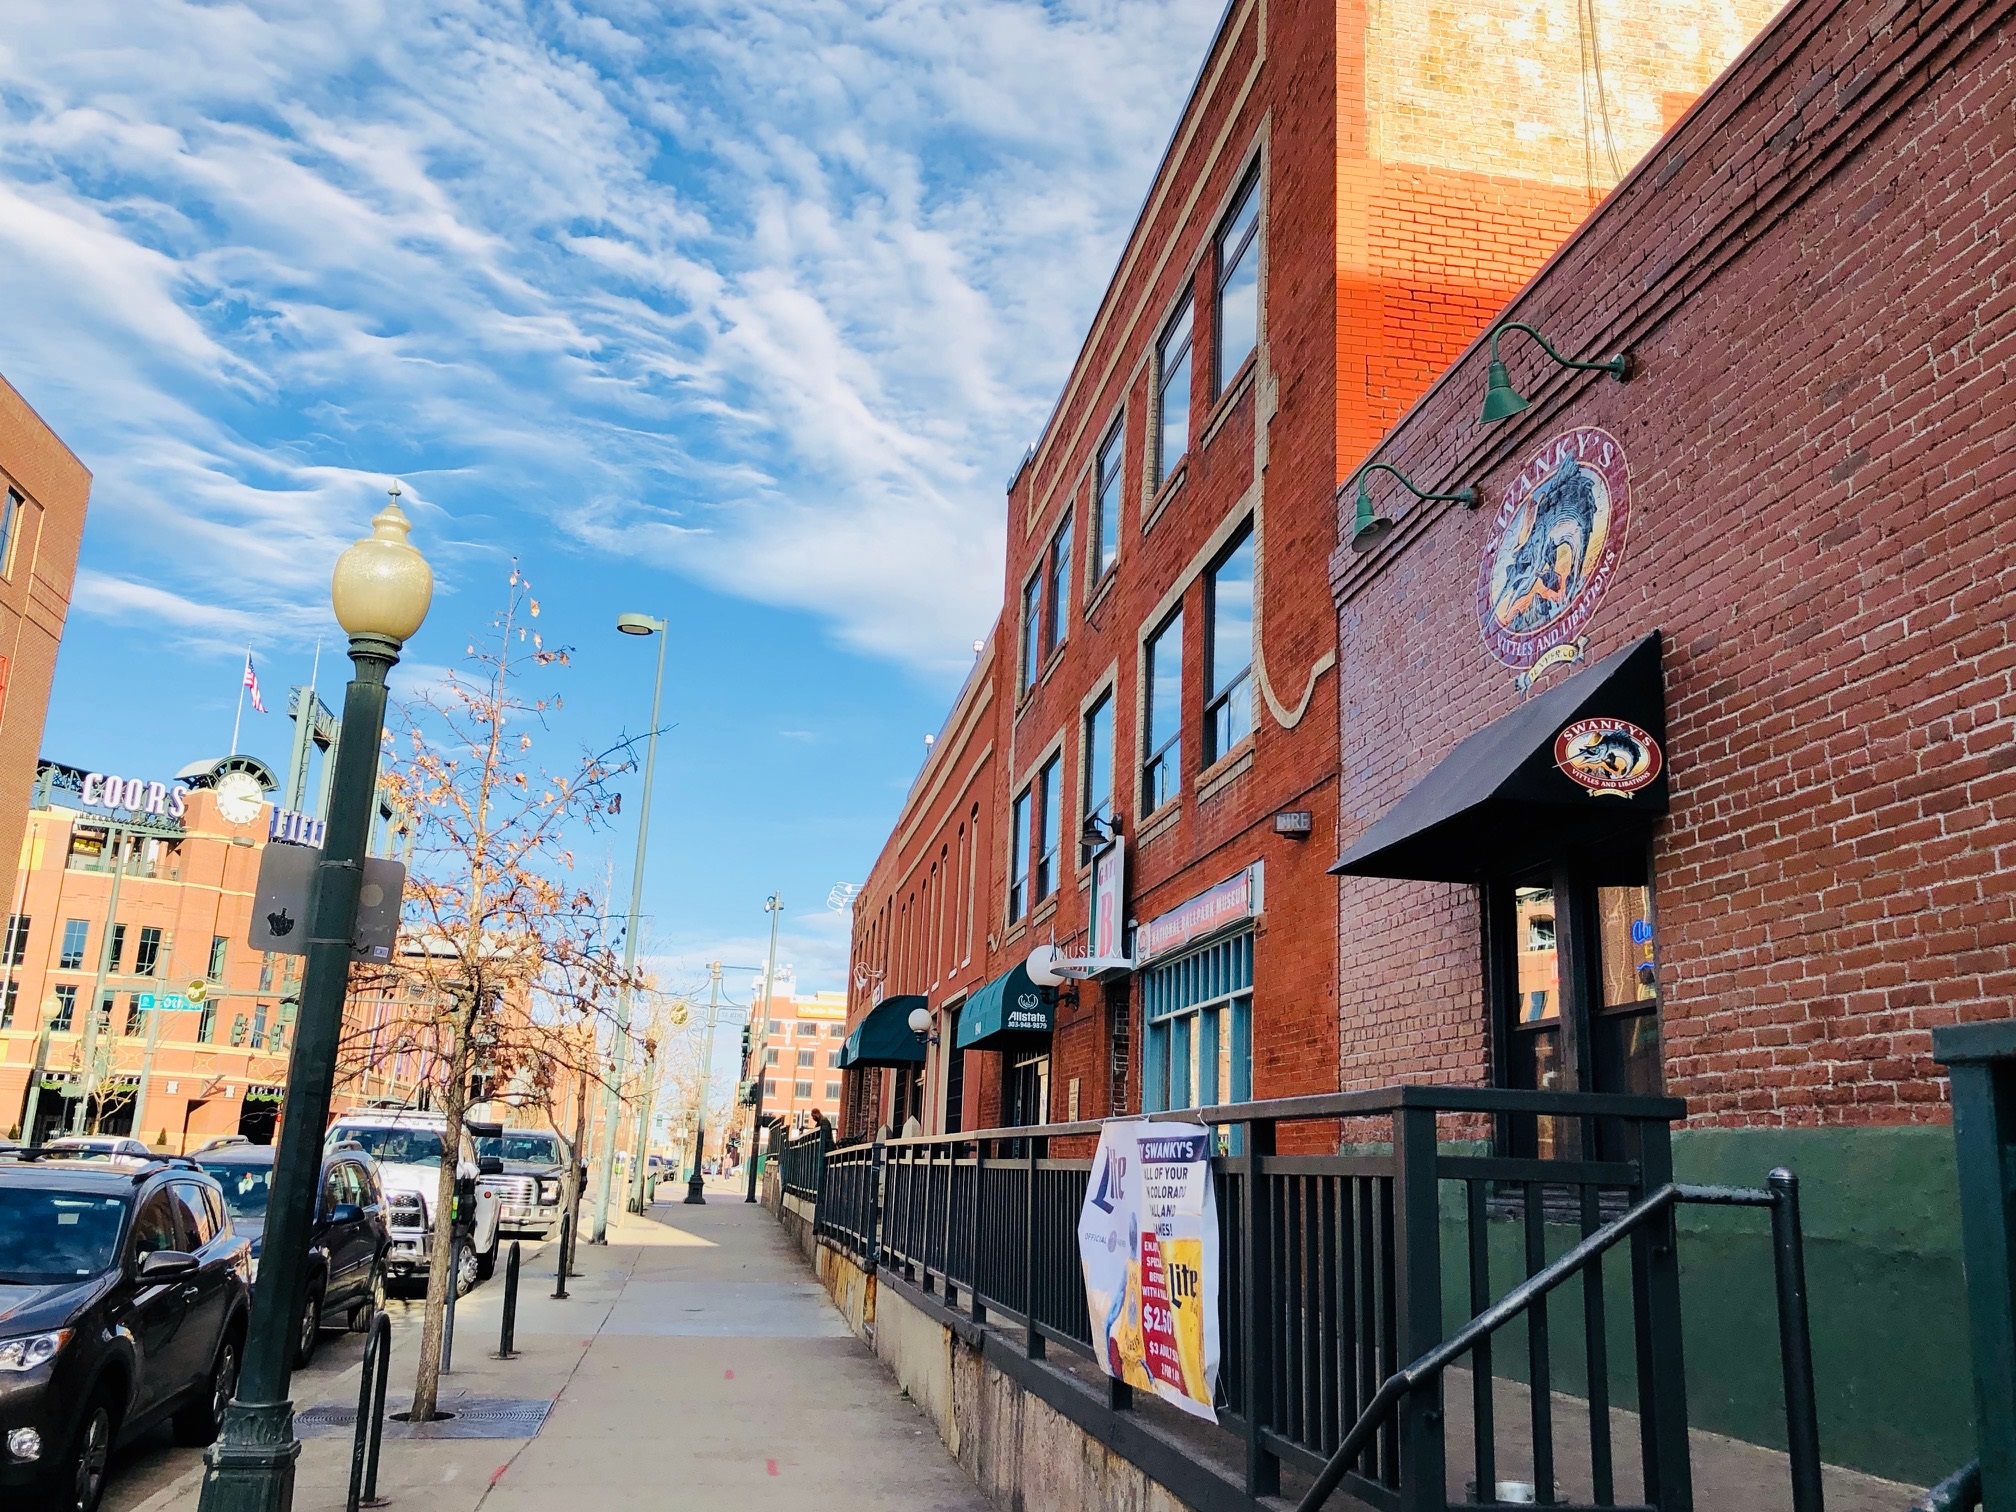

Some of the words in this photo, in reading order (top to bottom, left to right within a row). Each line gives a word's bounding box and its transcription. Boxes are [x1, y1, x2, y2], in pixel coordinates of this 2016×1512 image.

[1486, 433, 1614, 557] SWANKY'S
[1497, 633, 1533, 656] VITTLES
[1537, 629, 1560, 653] AND
[1562, 550, 1615, 635] LIBATIONS
[1563, 720, 1652, 747] SWANKY'S
[1571, 768, 1600, 786] VITTLES
[1600, 780, 1617, 788] AND
[1618, 772, 1651, 788] LIBATIONS
[83, 773, 187, 819] COORS
[271, 807, 325, 849] FIEL
[1099, 891, 1113, 957] B
[1150, 918, 1178, 946] NATIONAL
[1182, 900, 1214, 931] BALLPARK
[1216, 884, 1247, 914] MUSEUM
[1008, 1011, 1046, 1022] Allstate
[1145, 1141, 1193, 1159] SWANKY'S
[1091, 1146, 1126, 1214] Lite
[1154, 1167, 1163, 1180] OF
[1165, 1167, 1188, 1180] YOUR
[1161, 1205, 1176, 1217] AND
[1084, 1232, 1107, 1244] OFFICIAL
[1168, 1263, 1198, 1309] Lite
[1149, 1340, 1159, 1356] $3
